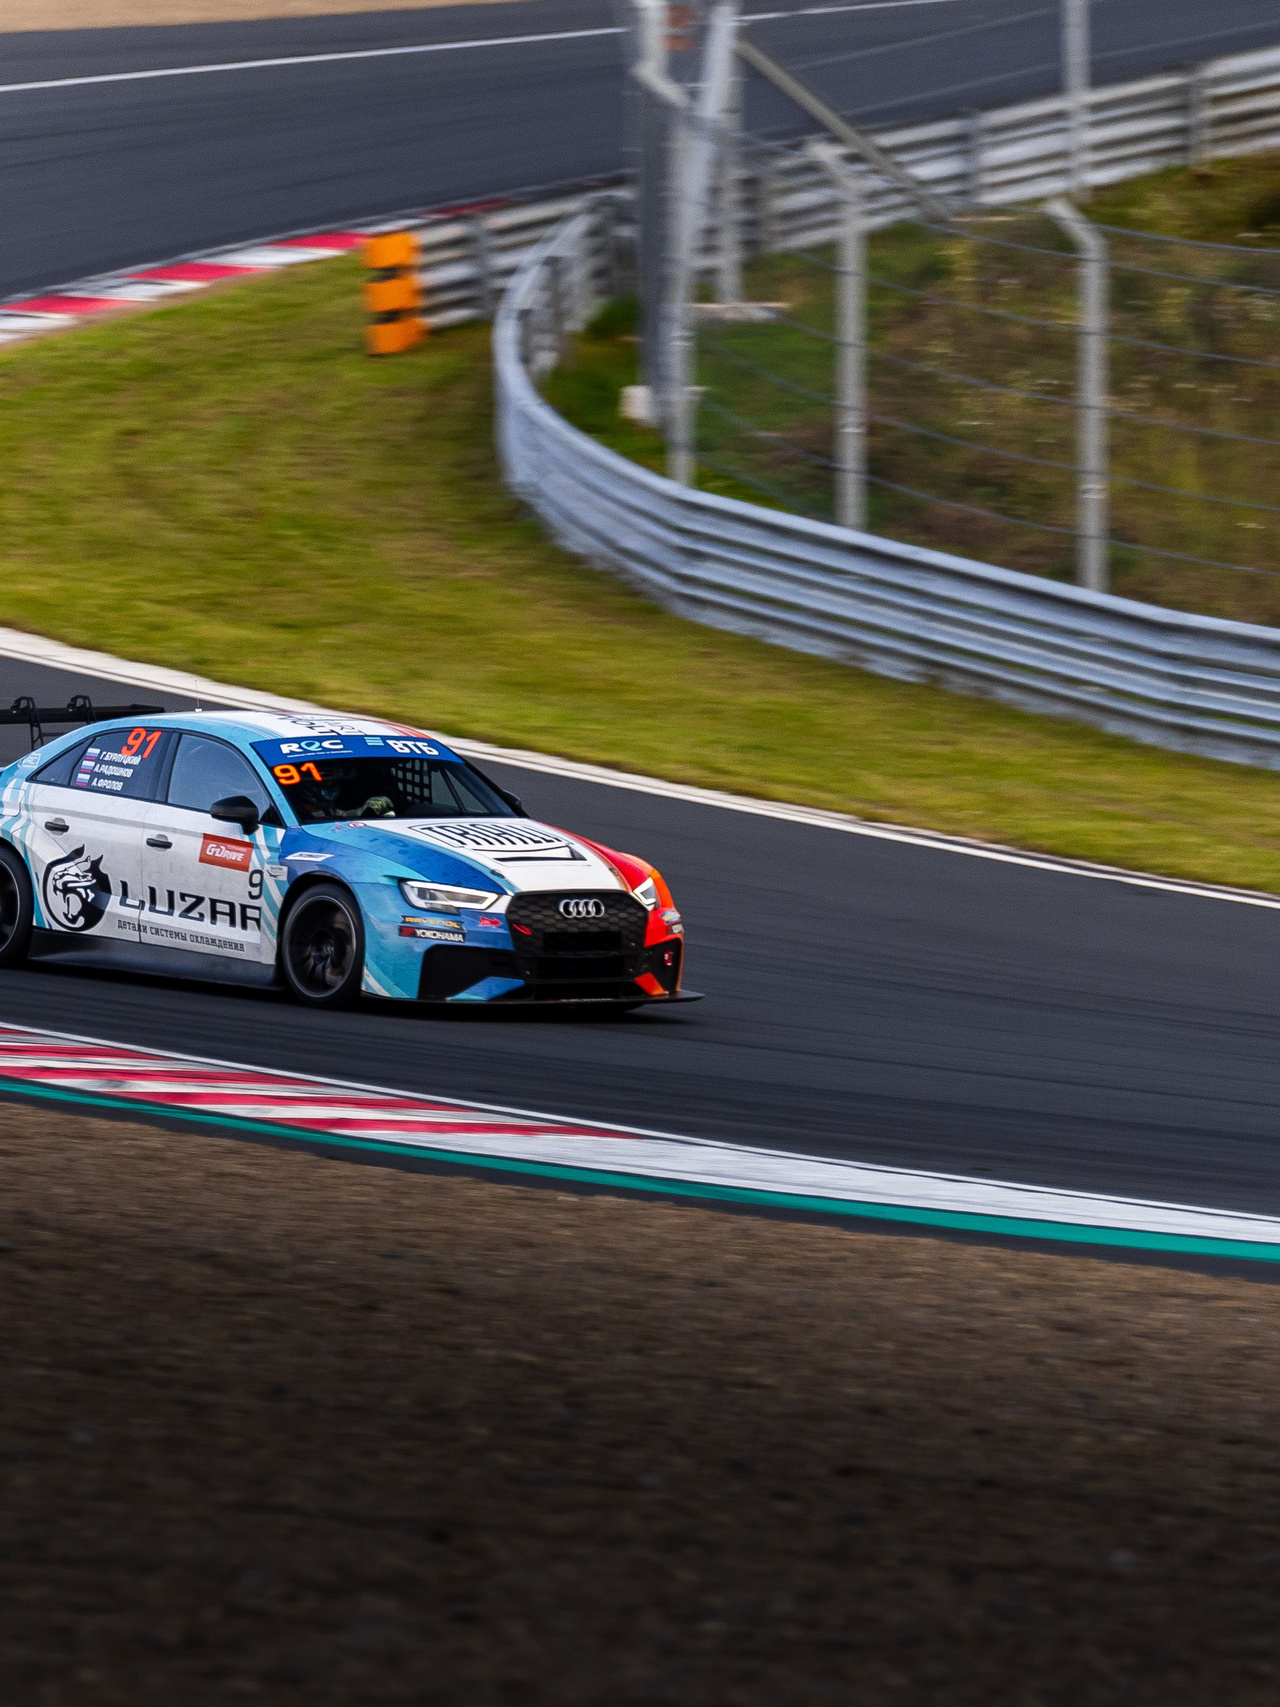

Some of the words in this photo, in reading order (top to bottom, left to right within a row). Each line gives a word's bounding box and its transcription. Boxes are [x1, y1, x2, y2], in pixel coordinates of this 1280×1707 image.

[120, 727, 162, 759] 91
[386, 739, 439, 756] ВТБ
[273, 762, 322, 786] 91
[247, 868, 264, 900] 9
[149, 926, 188, 942] системы
[189, 934, 245, 952] охлаждения
[415, 929, 464, 942] YOKOHAMA
